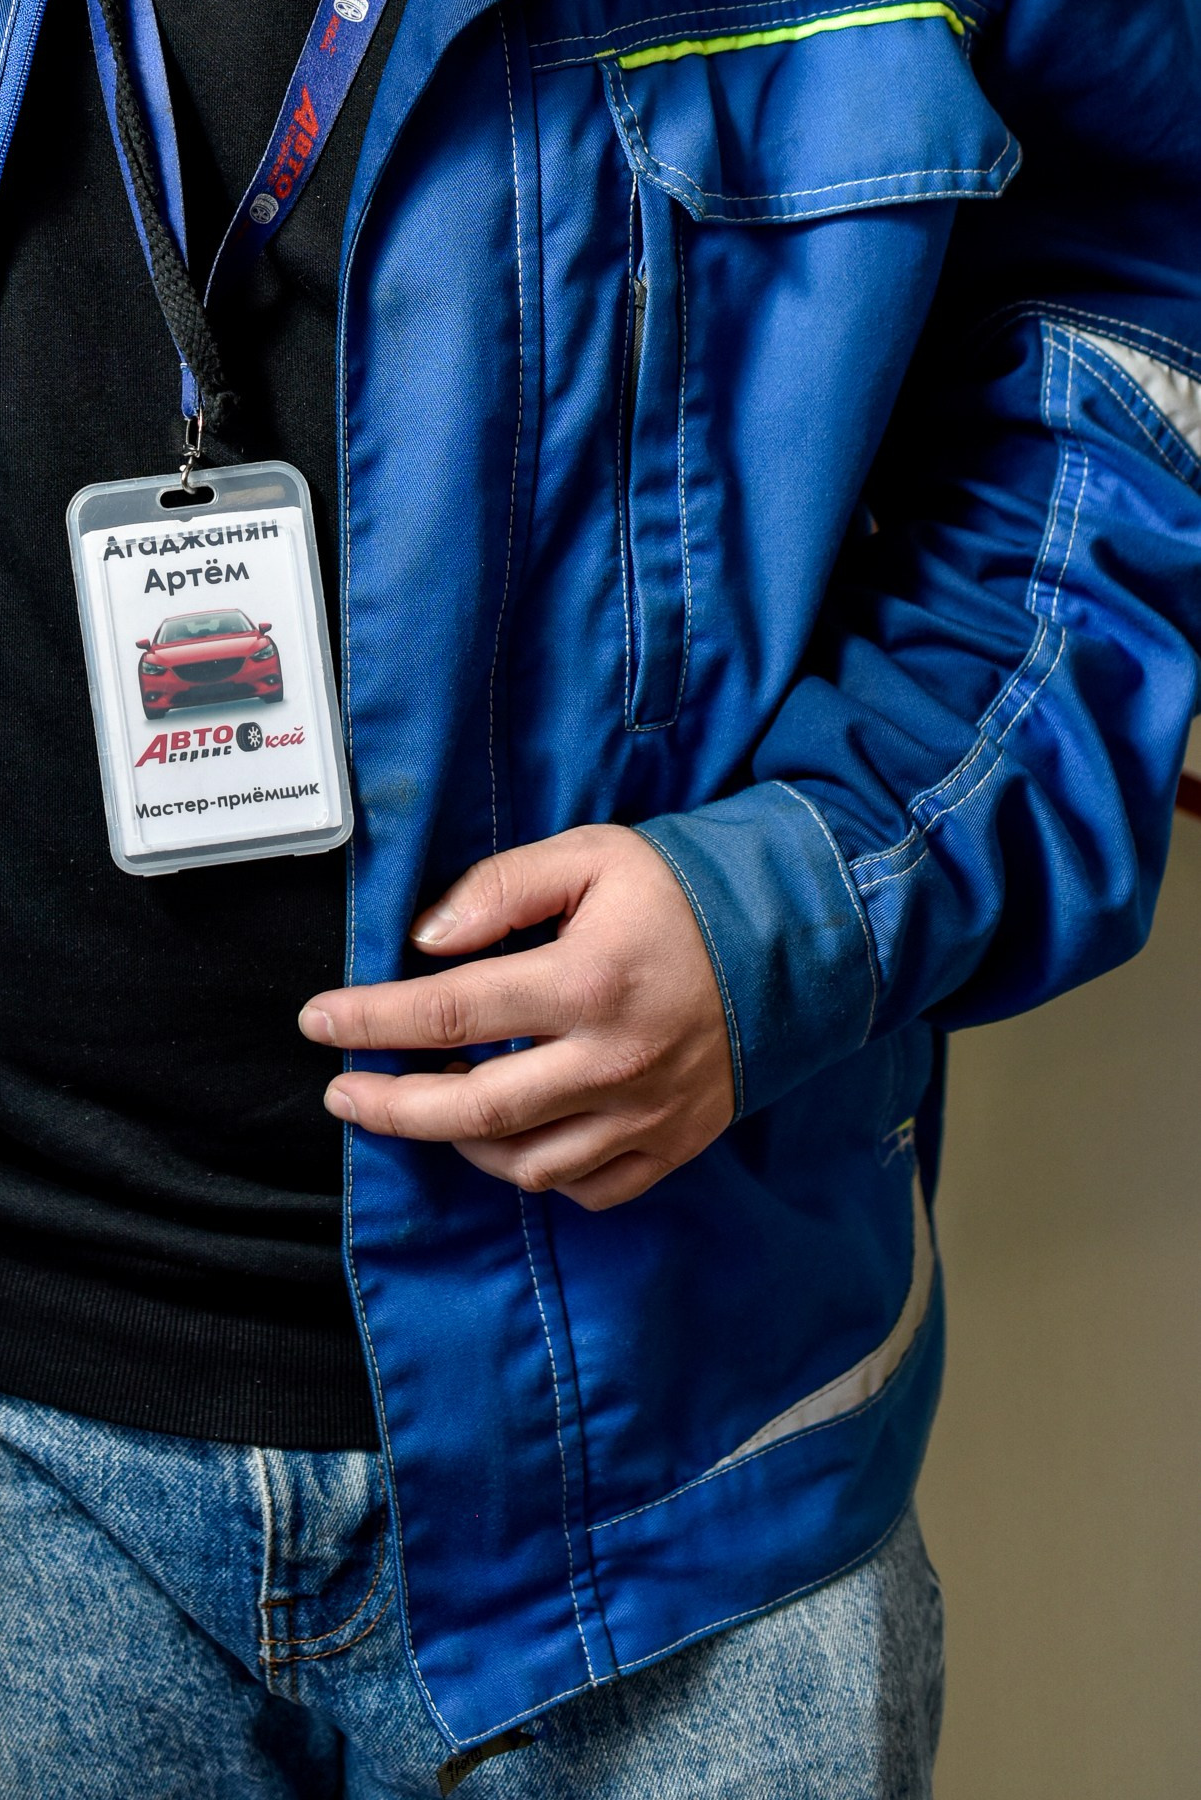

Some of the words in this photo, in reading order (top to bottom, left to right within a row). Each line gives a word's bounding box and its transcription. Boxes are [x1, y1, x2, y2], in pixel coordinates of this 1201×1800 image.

[275, 84, 319, 200] АВТО
[103, 520, 279, 561] Агаджанян
[144, 558, 250, 596] Артём
[134, 725, 234, 768] АВТО
[265, 725, 306, 749] кей
[168, 745, 233, 763] сервис
[135, 782, 320, 819] Мастер-приёмщик
